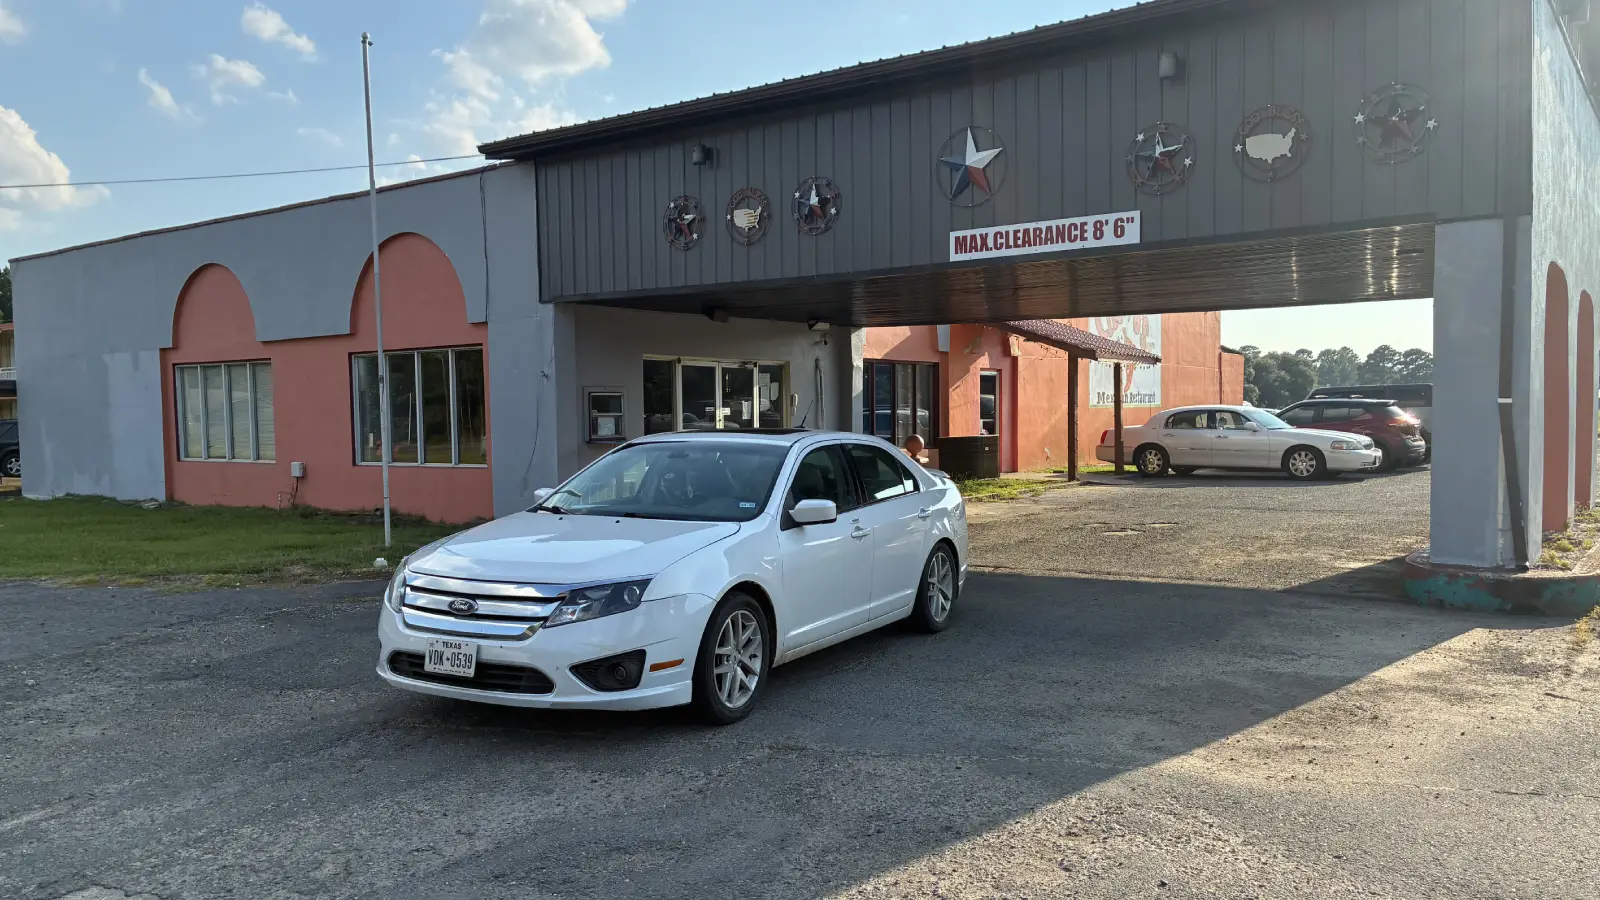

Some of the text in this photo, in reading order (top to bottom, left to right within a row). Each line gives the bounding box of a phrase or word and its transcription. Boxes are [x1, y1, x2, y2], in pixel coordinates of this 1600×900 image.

[1239, 105, 1305, 135] GOD BLESS
[730, 191, 743, 208] GOD
[954, 216, 1135, 255] MAX.CLEARANCE 8' 6"
[1096, 390, 1156, 405] Mexn Restaurant
[451, 600, 470, 610] Ford
[442, 641, 462, 650] TEXAS
